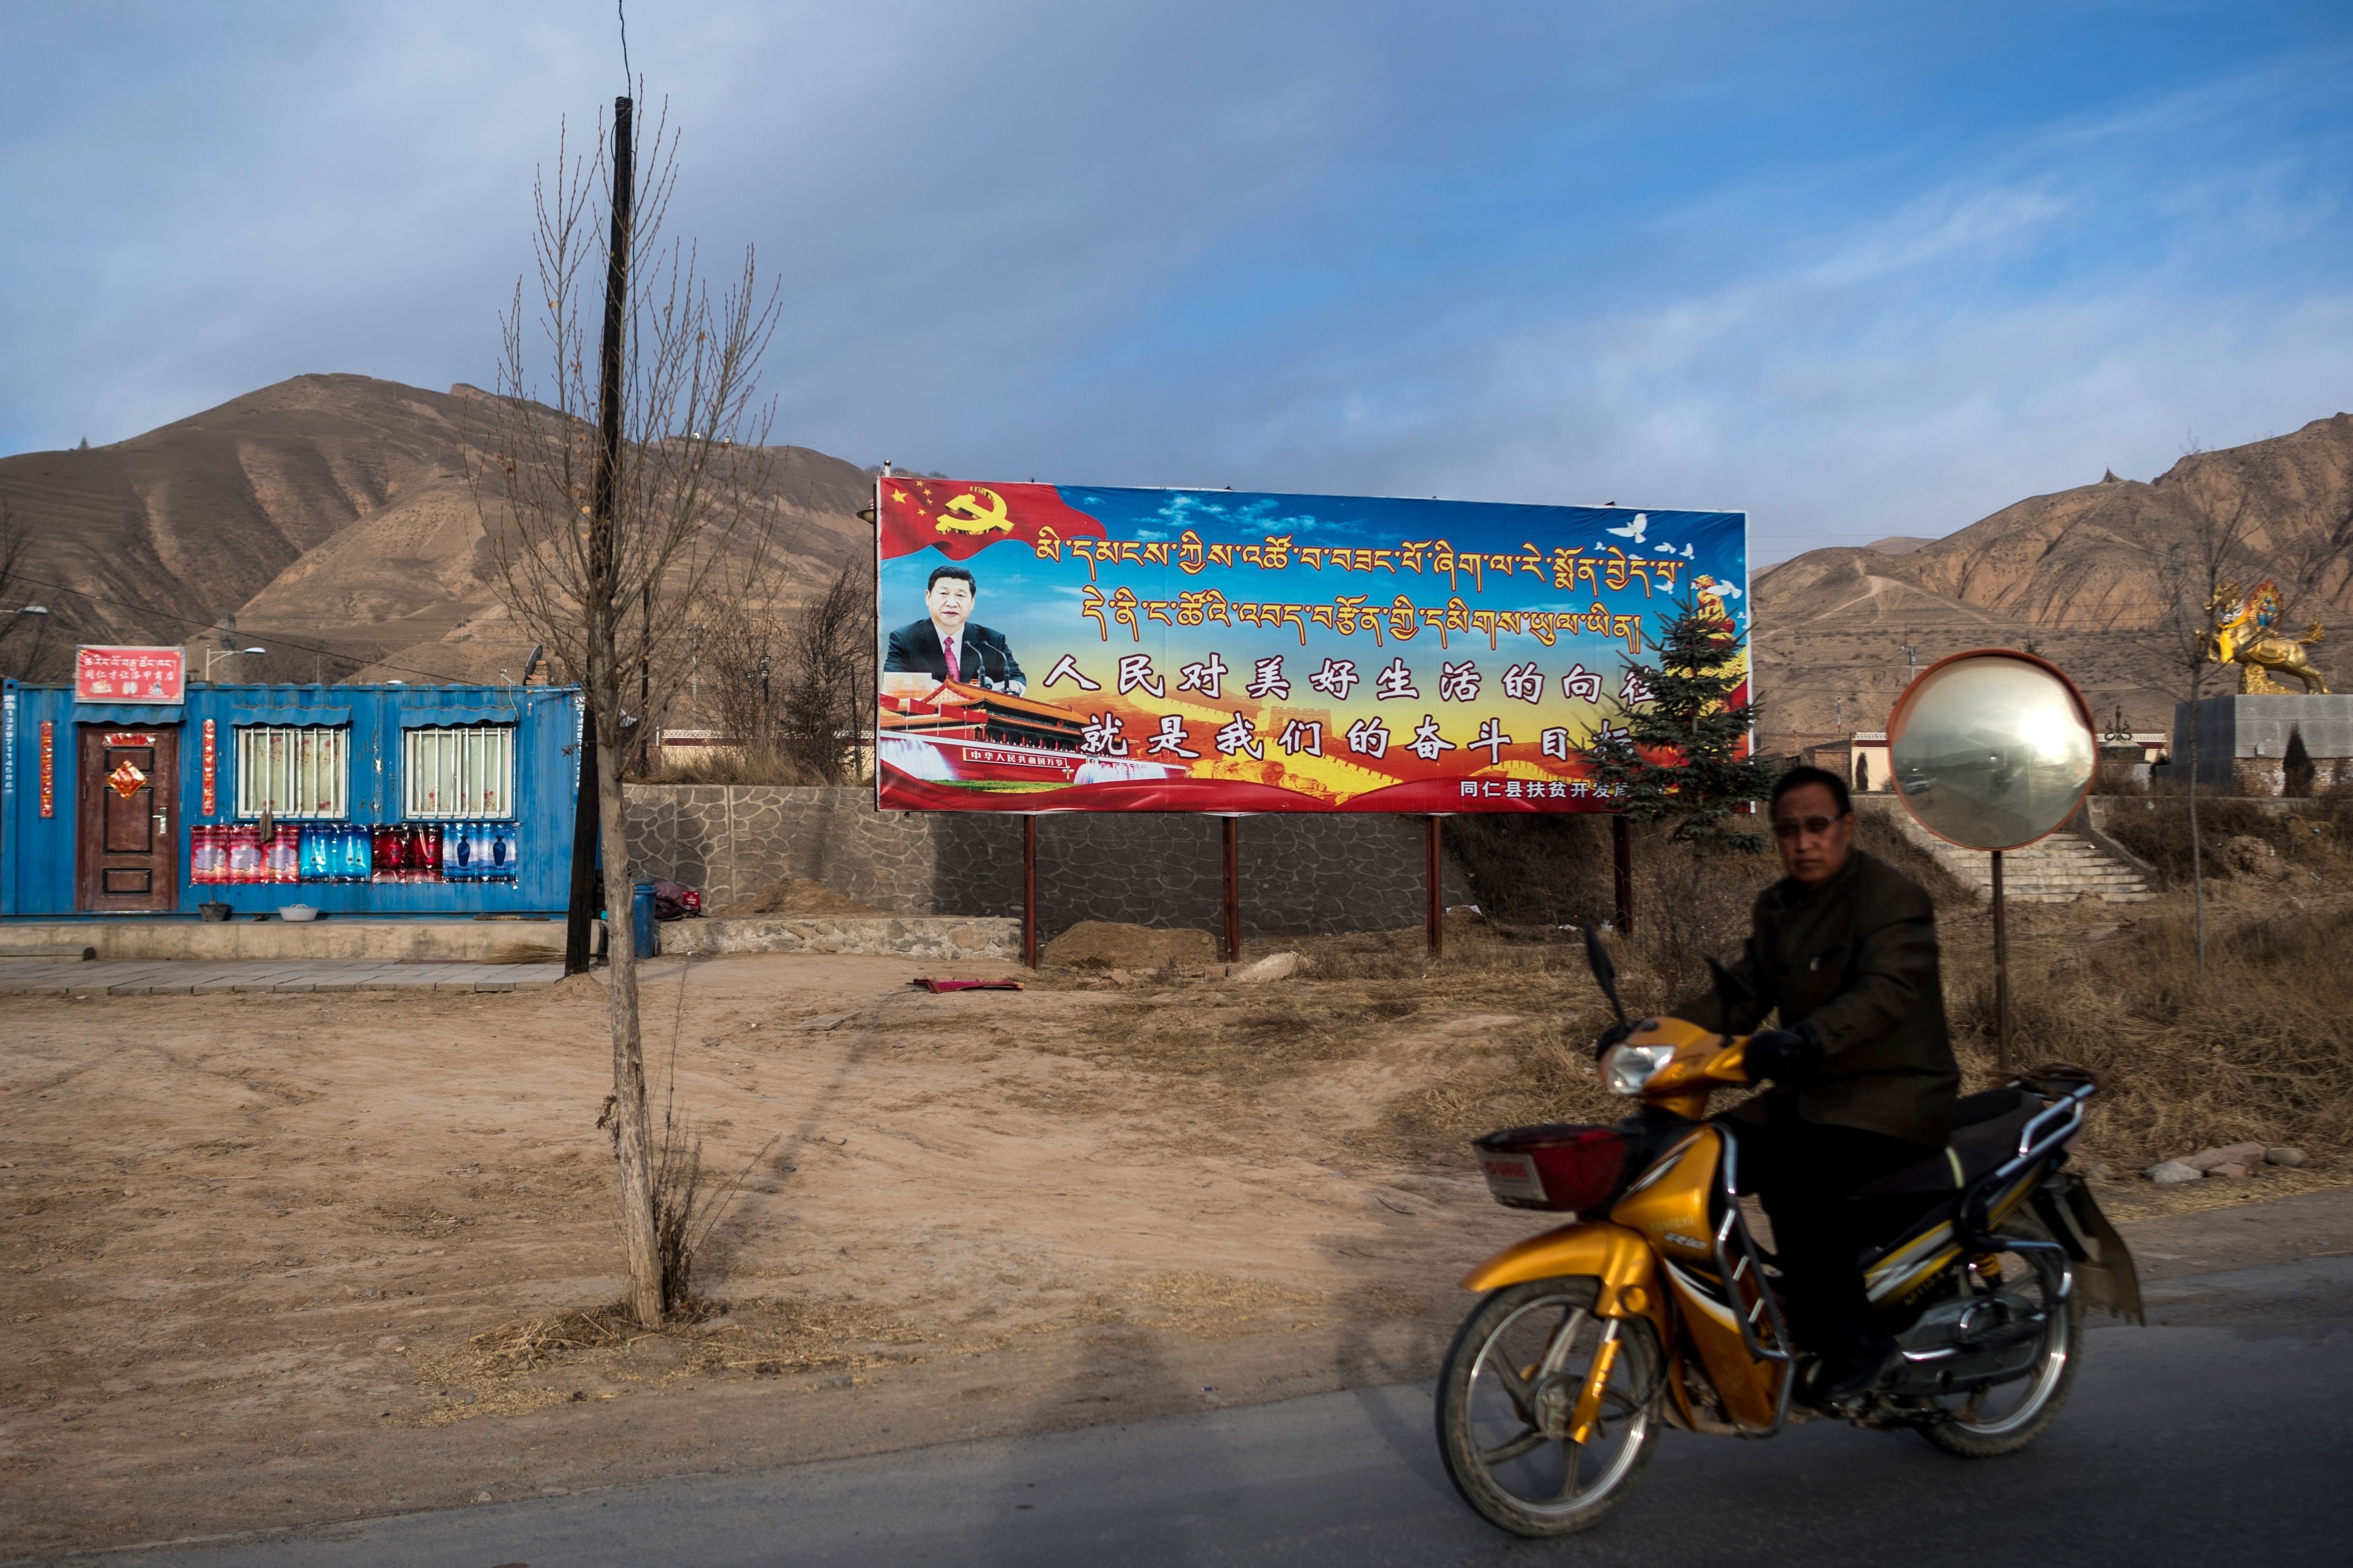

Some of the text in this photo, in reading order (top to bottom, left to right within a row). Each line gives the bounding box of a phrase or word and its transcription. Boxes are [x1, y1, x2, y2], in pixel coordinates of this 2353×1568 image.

[971, 750, 1063, 766] 中华人民共和国万岁
